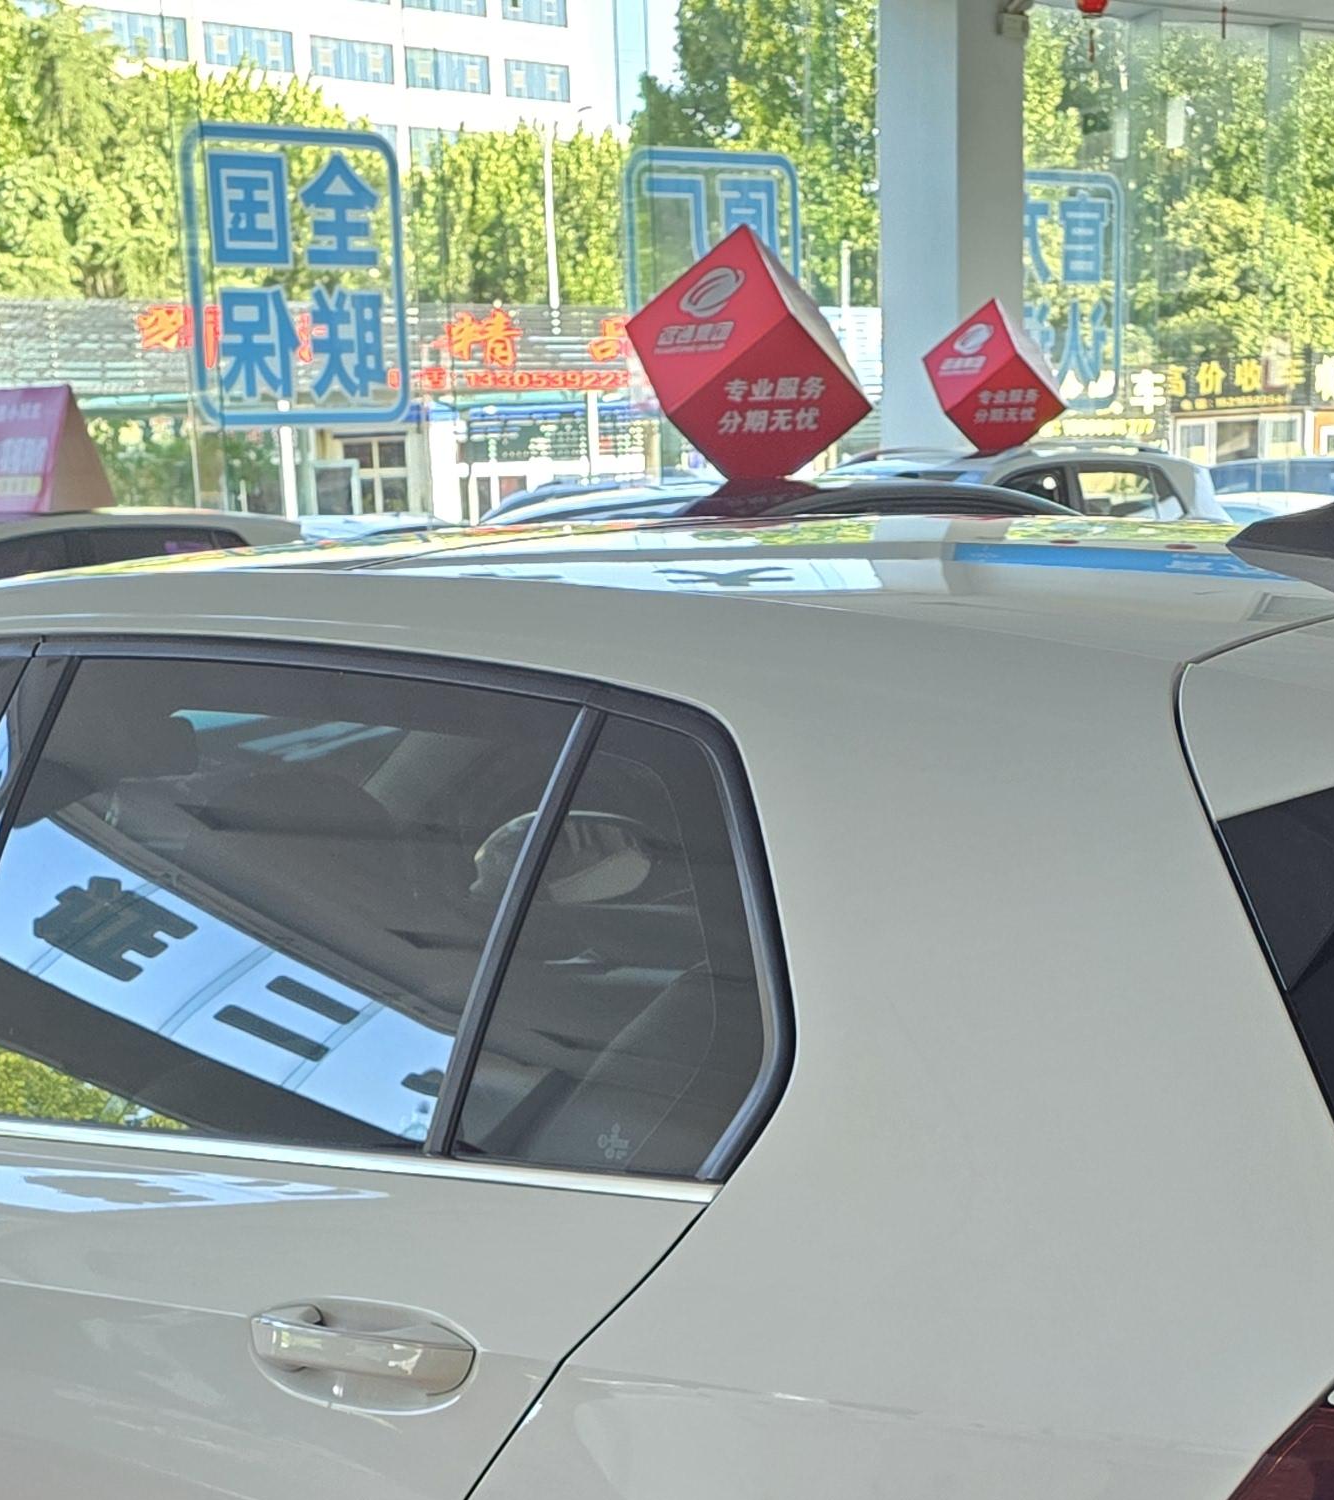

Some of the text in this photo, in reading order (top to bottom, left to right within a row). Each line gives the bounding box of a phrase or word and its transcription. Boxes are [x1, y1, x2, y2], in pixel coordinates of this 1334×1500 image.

[723, 375, 826, 402] 专业服务
[717, 407, 821, 434] 分期无忧
